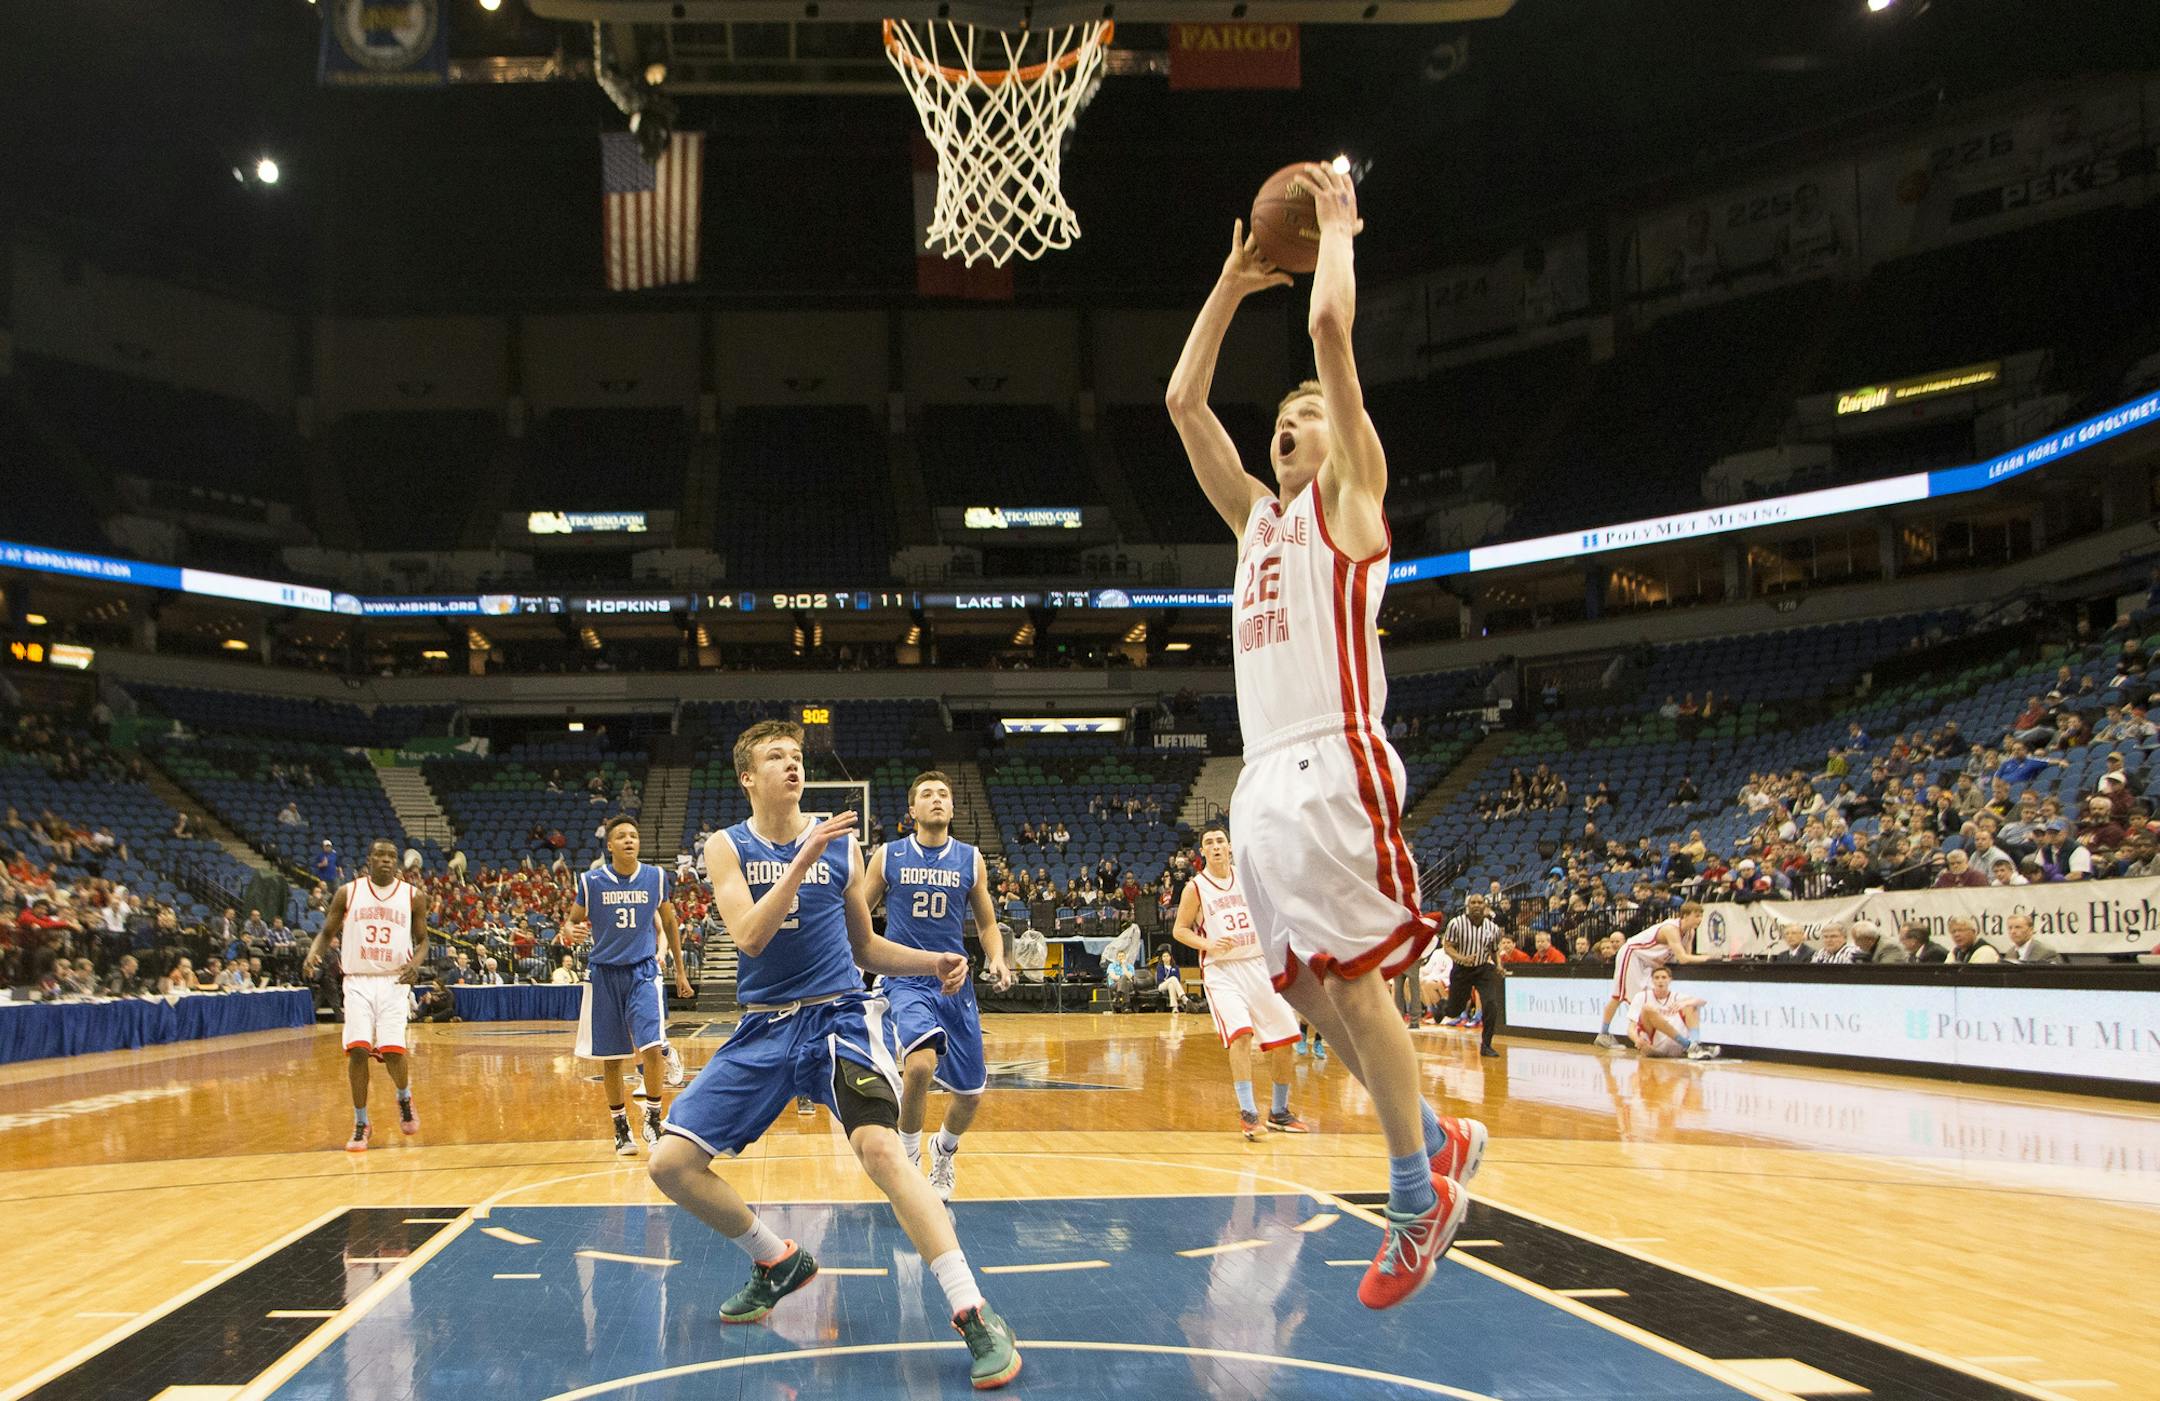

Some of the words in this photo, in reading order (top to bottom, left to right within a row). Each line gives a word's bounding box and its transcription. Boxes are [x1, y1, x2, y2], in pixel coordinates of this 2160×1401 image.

[1180, 24, 1293, 50] FARGO
[1989, 453, 2025, 479] LEARN
[2027, 438, 2059, 465] MORE
[2060, 431, 2077, 450] AT
[1241, 557, 1282, 610] 22
[586, 599, 671, 613] HOPKINS
[773, 593, 828, 609] 9:02
[956, 595, 1003, 609] LAKE
[1011, 595, 1026, 609] N
[1053, 598, 1063, 608] 4
[1074, 598, 1083, 608] 3
[1132, 594, 1233, 605] WWW.MSHSL.OR
[1153, 733, 1207, 749] LIFETIME
[746, 860, 831, 886] HOPNS
[900, 867, 960, 888] HOPKINS
[602, 890, 649, 904] HOPKINS
[912, 891, 947, 918] 20
[615, 907, 637, 928] 31
[1223, 912, 1250, 931] 32
[2089, 899, 2160, 943] High
[365, 924, 391, 944] 33
